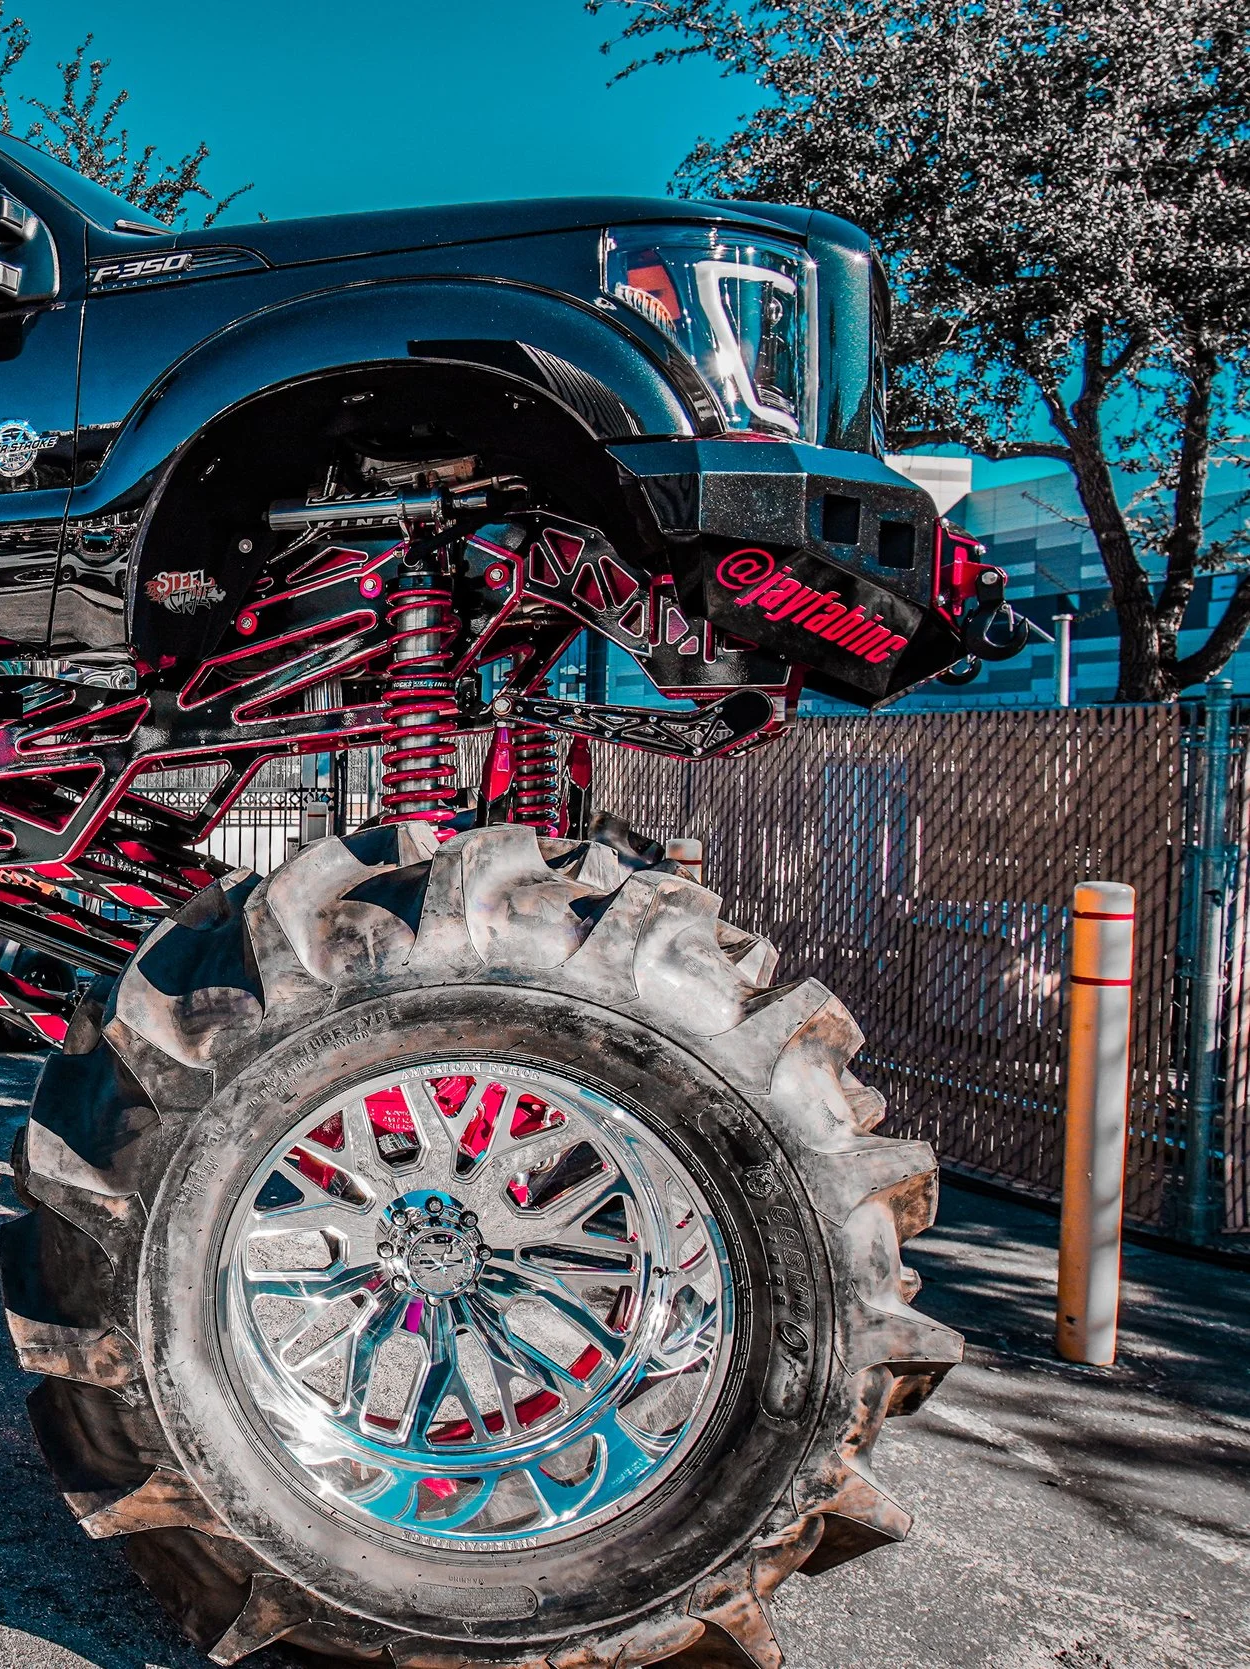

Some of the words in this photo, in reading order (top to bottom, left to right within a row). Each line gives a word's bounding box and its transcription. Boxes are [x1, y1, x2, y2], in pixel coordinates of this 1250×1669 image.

[93, 254, 191, 283] F-350
[10, 436, 59, 453] STROKE
[156, 568, 212, 593] STEEL
[716, 548, 908, 664] @jayfabinc
[298, 1025, 347, 1055] TUBE
[350, 1006, 401, 1032] TYPE
[333, 1029, 371, 1050] NYLON
[280, 1054, 316, 1084] RATING
[401, 1062, 483, 1080] AMERICAN
[489, 1063, 541, 1080] FORCE
[770, 1205, 811, 1322] COSMO
[457, 1537, 539, 1550] AMERICAN
